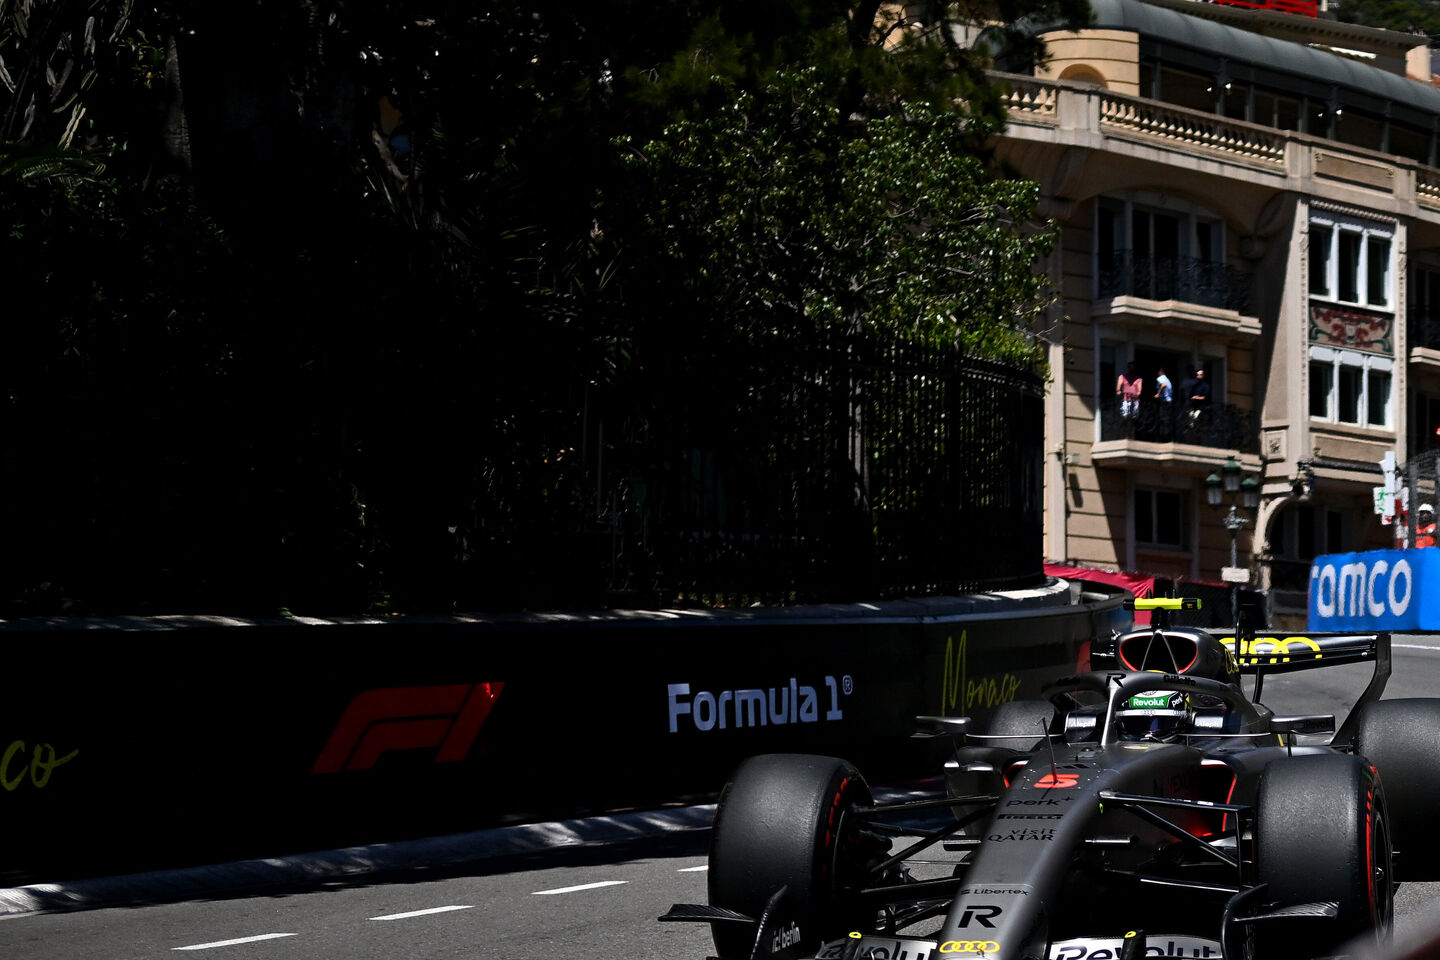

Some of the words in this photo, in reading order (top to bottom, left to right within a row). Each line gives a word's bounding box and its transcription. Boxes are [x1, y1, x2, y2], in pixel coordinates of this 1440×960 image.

[941, 629, 1021, 718] Monaco
[666, 677, 819, 733] Formula
[1133, 698, 1165, 707] Revolut
[1033, 774, 1080, 788] 5
[1011, 827, 1056, 835] visit
[988, 834, 1054, 842] QATAR
[974, 887, 1029, 896] Libertex
